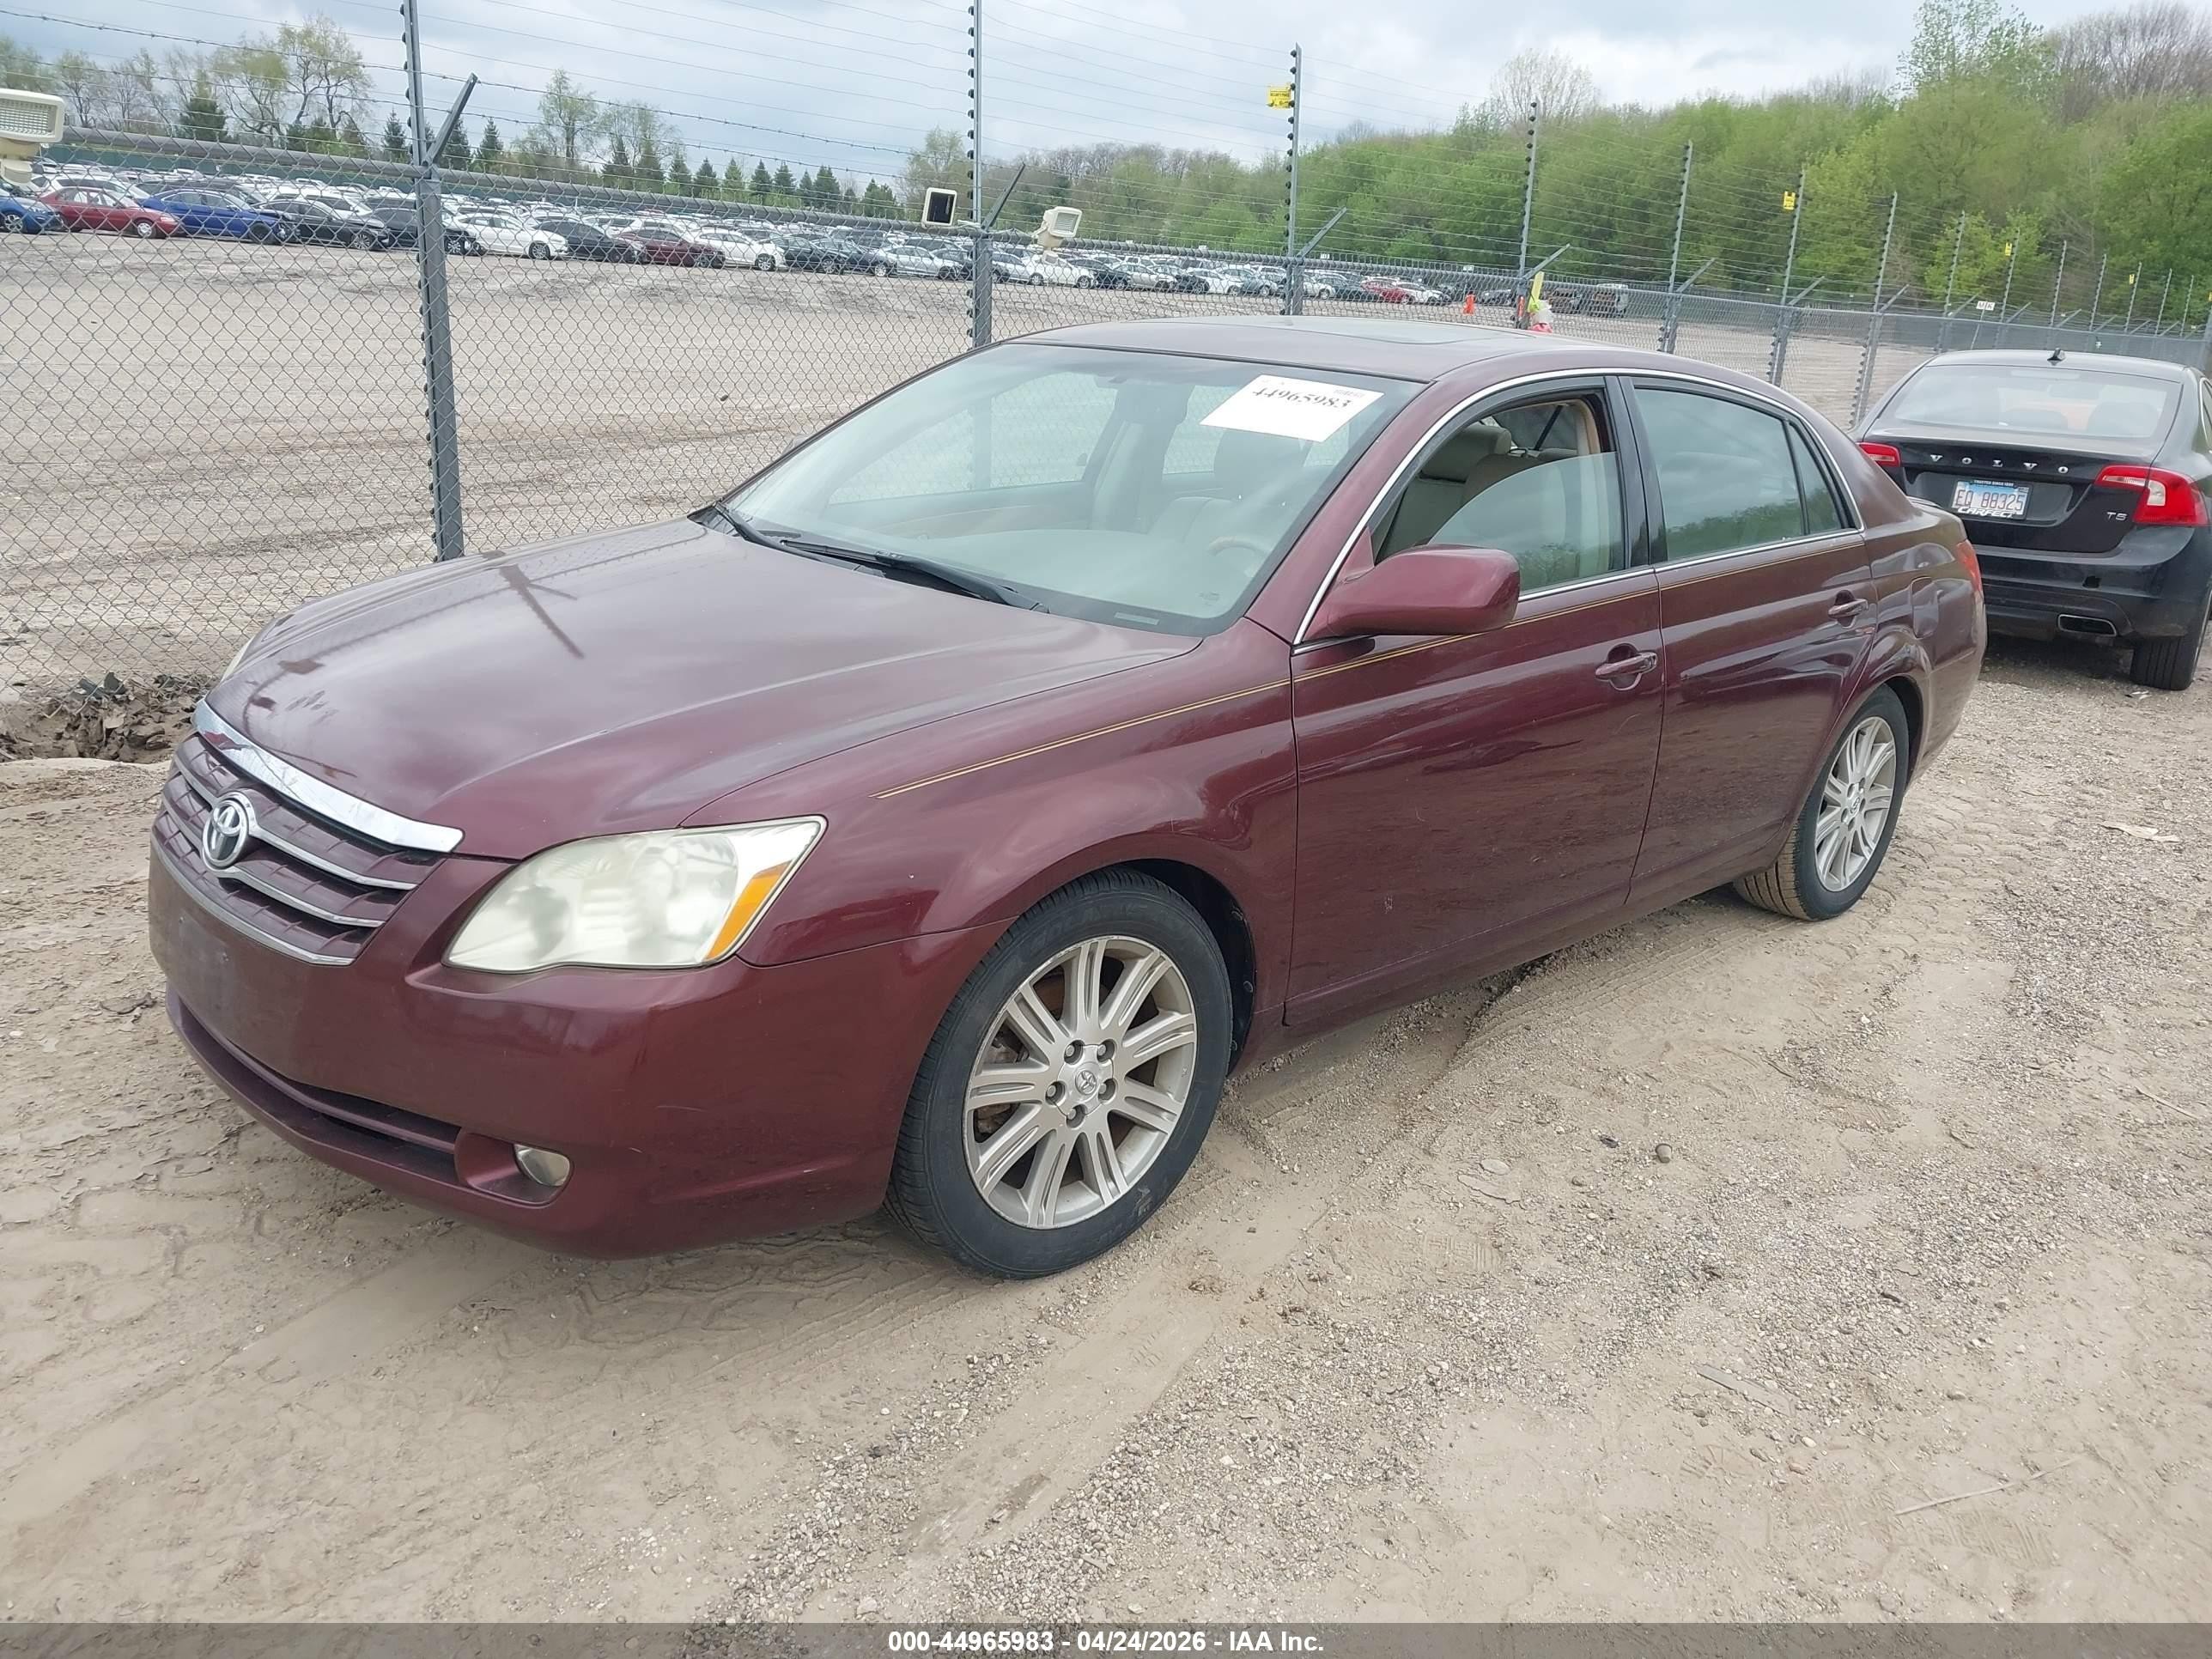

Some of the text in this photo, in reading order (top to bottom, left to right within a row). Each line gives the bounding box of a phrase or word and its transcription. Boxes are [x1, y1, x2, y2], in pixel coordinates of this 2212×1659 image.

[1253, 387, 1352, 408] 44965983
[1930, 454, 2069, 474] VOLVO
[1955, 489, 2026, 511] EQ 88325
[2106, 511, 2128, 521] T5
